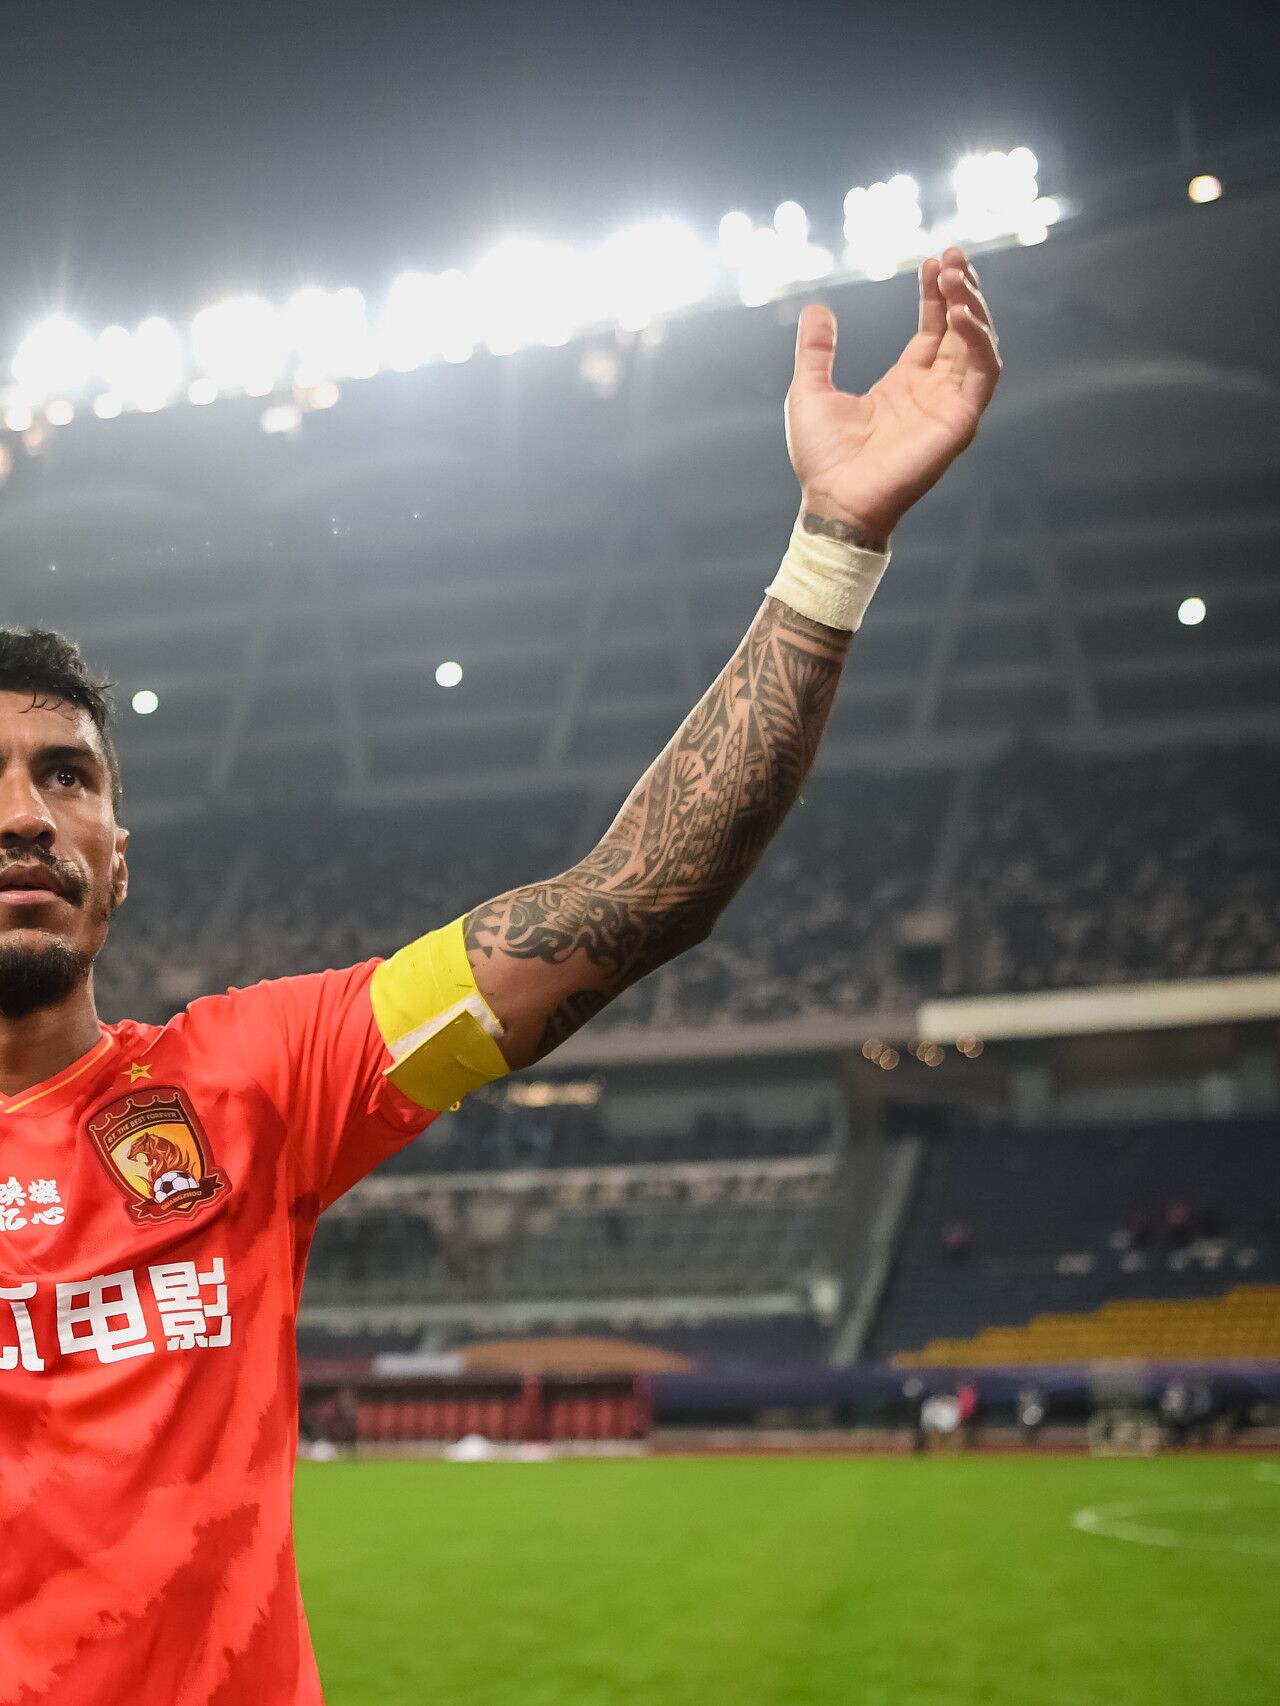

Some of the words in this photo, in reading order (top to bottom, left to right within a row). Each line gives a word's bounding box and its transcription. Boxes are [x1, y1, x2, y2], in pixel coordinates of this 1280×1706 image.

[107, 1132, 117, 1143] BE
[118, 1125, 130, 1134] THE
[130, 1116, 145, 1127] BEST
[146, 1112, 177, 1120] FOREVER
[160, 1190, 202, 1210] GUANGZHOU
